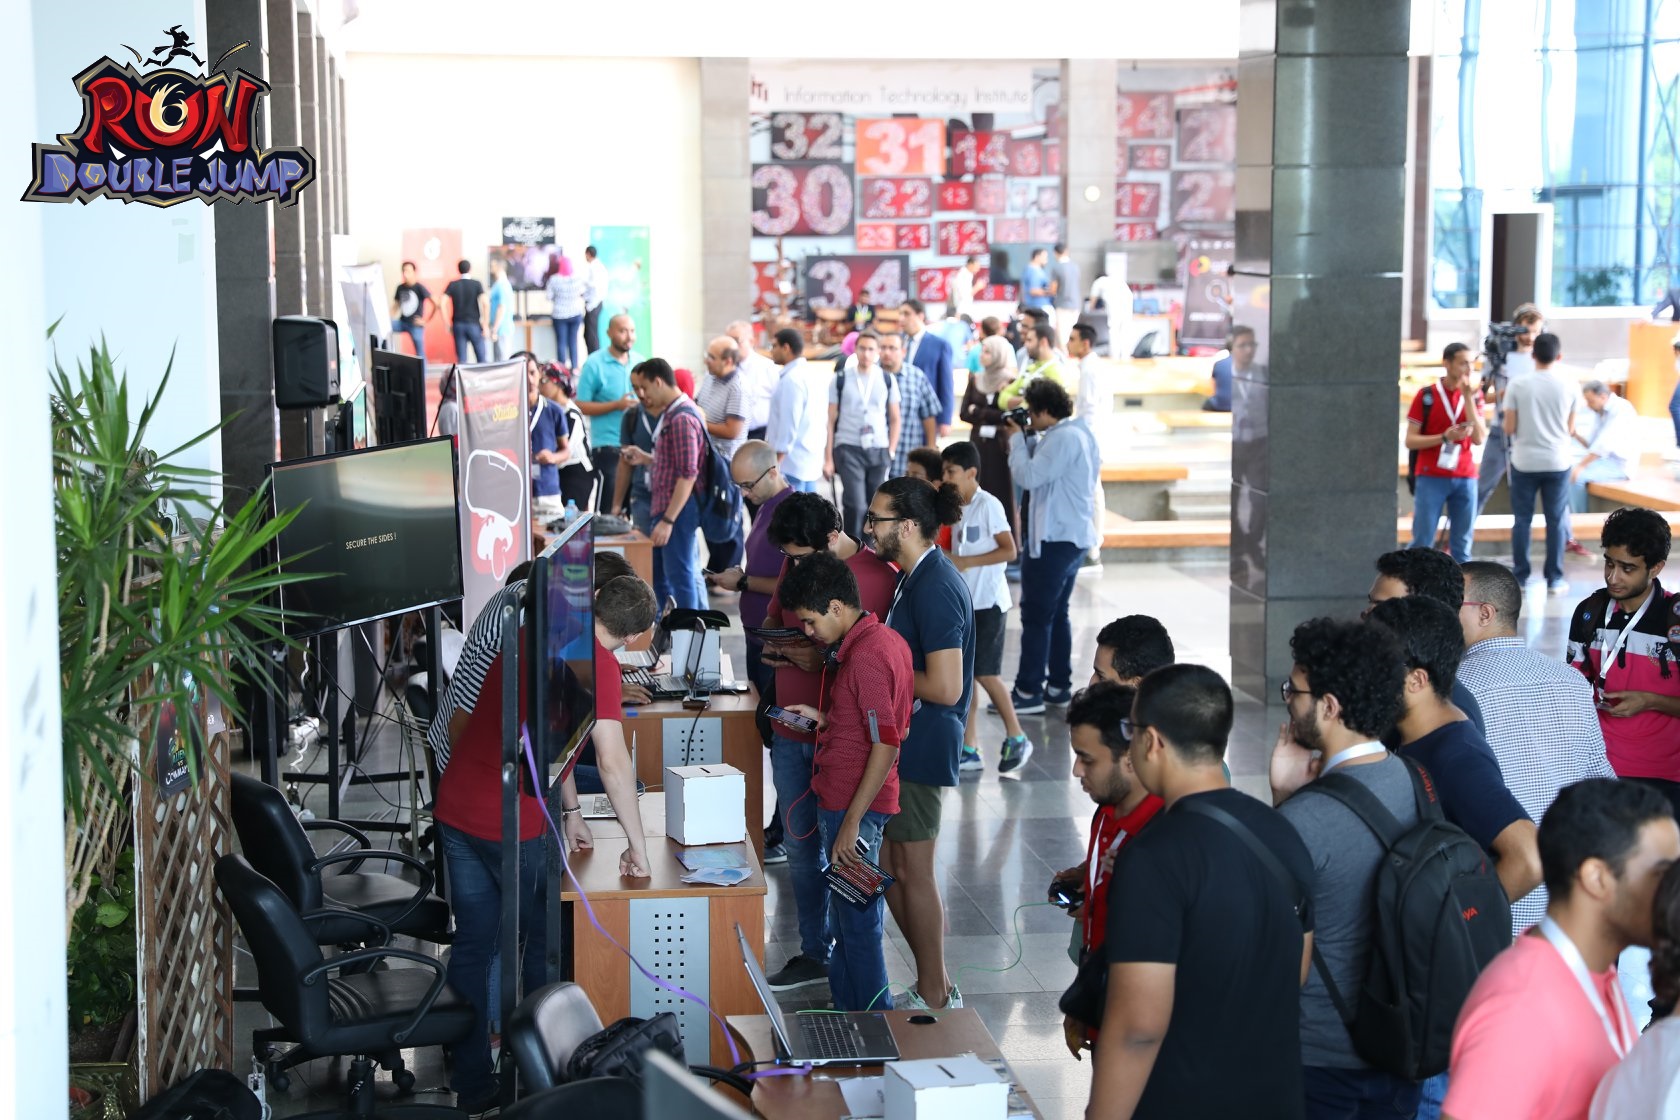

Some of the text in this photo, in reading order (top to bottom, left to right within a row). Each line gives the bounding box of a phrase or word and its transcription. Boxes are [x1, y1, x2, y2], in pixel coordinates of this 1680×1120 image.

[784, 86, 872, 103] Information
[880, 85, 968, 109] Technology
[773, 113, 843, 160] 32
[863, 121, 942, 175] 31
[955, 134, 1010, 172] 14
[751, 164, 853, 235] 30
[865, 179, 931, 218] 22
[939, 220, 987, 254] 12
[808, 259, 908, 309] 34
[345, 538, 367, 550] SECURE
[367, 536, 378, 545] THE
[378, 532, 394, 543] SIDES
